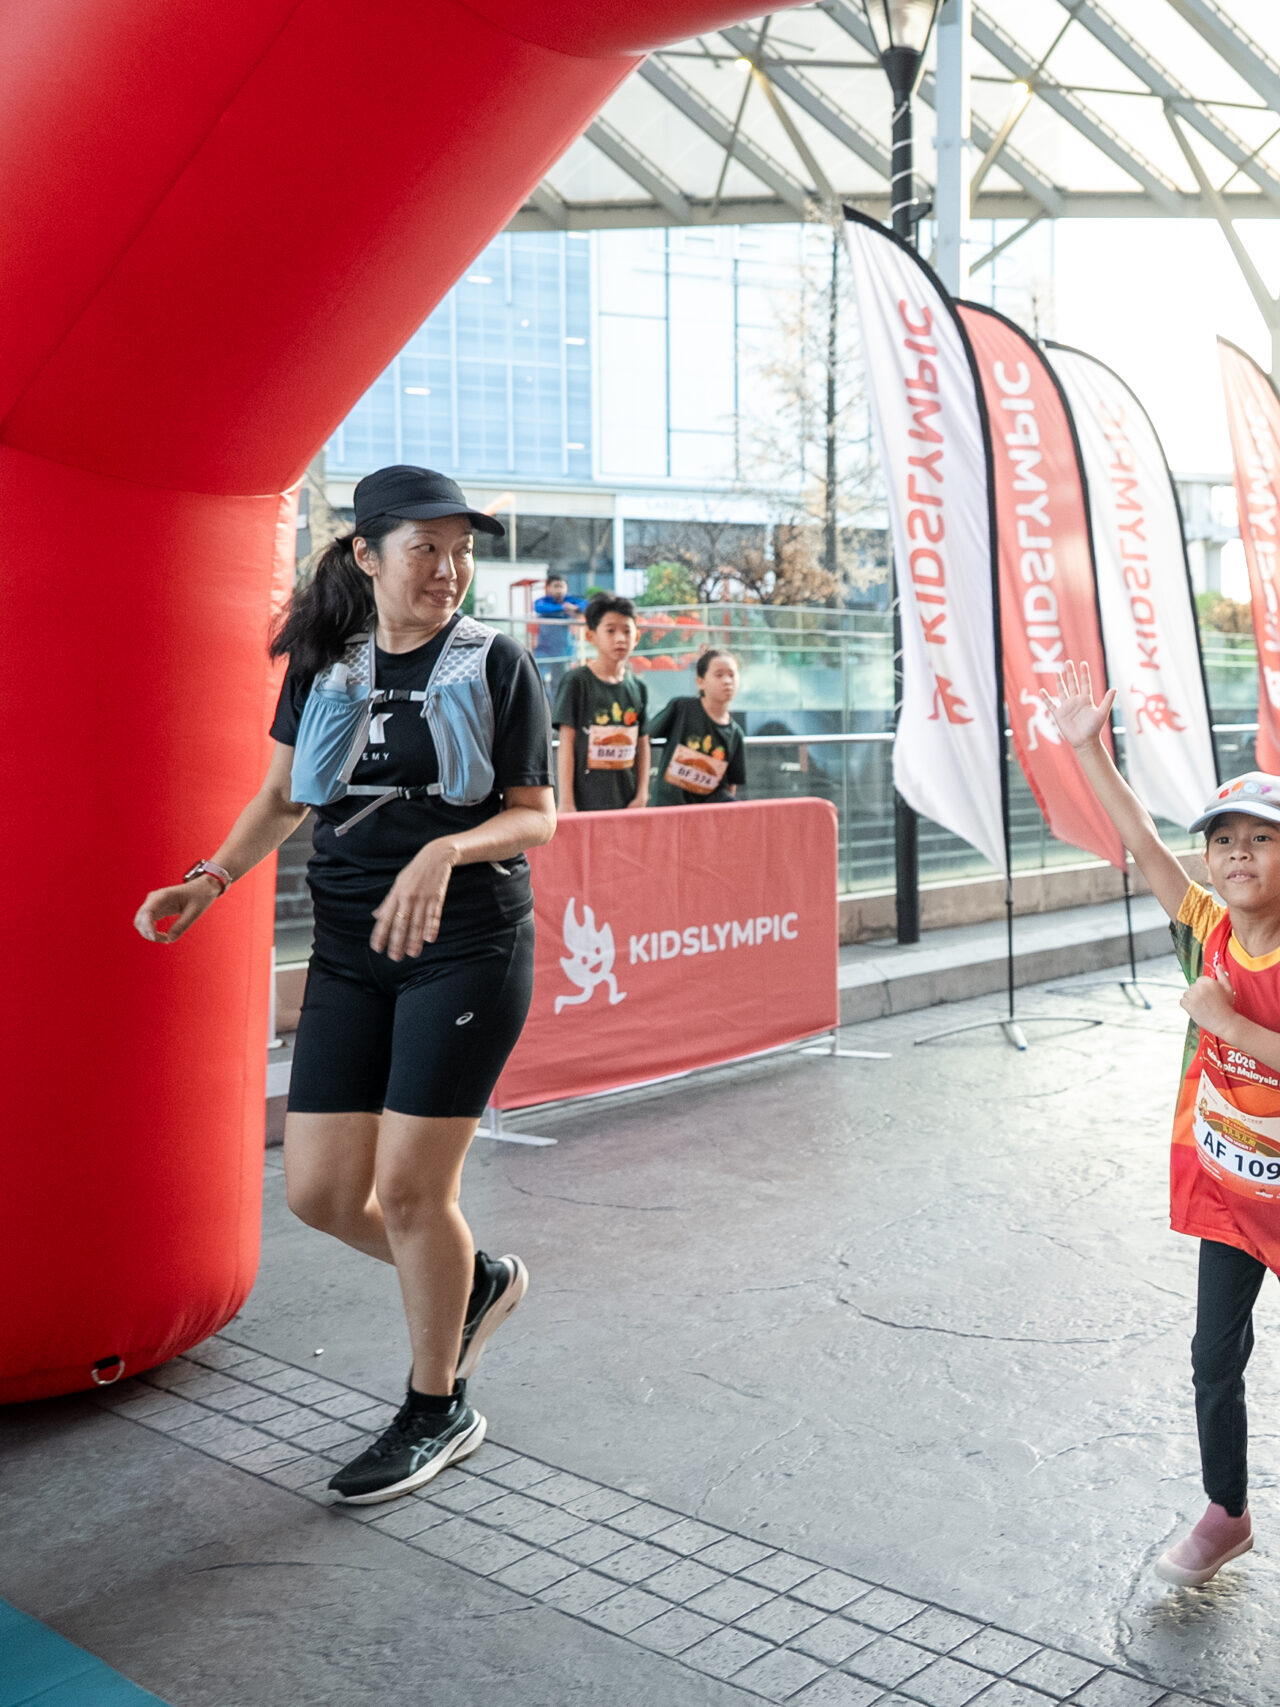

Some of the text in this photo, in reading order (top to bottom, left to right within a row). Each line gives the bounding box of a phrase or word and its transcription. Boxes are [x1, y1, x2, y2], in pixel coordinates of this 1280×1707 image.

[628, 912, 799, 965] KIDSLYMPIC
[1237, 1066, 1278, 1086] Malaysia
[1203, 1131, 1227, 1158] AF
